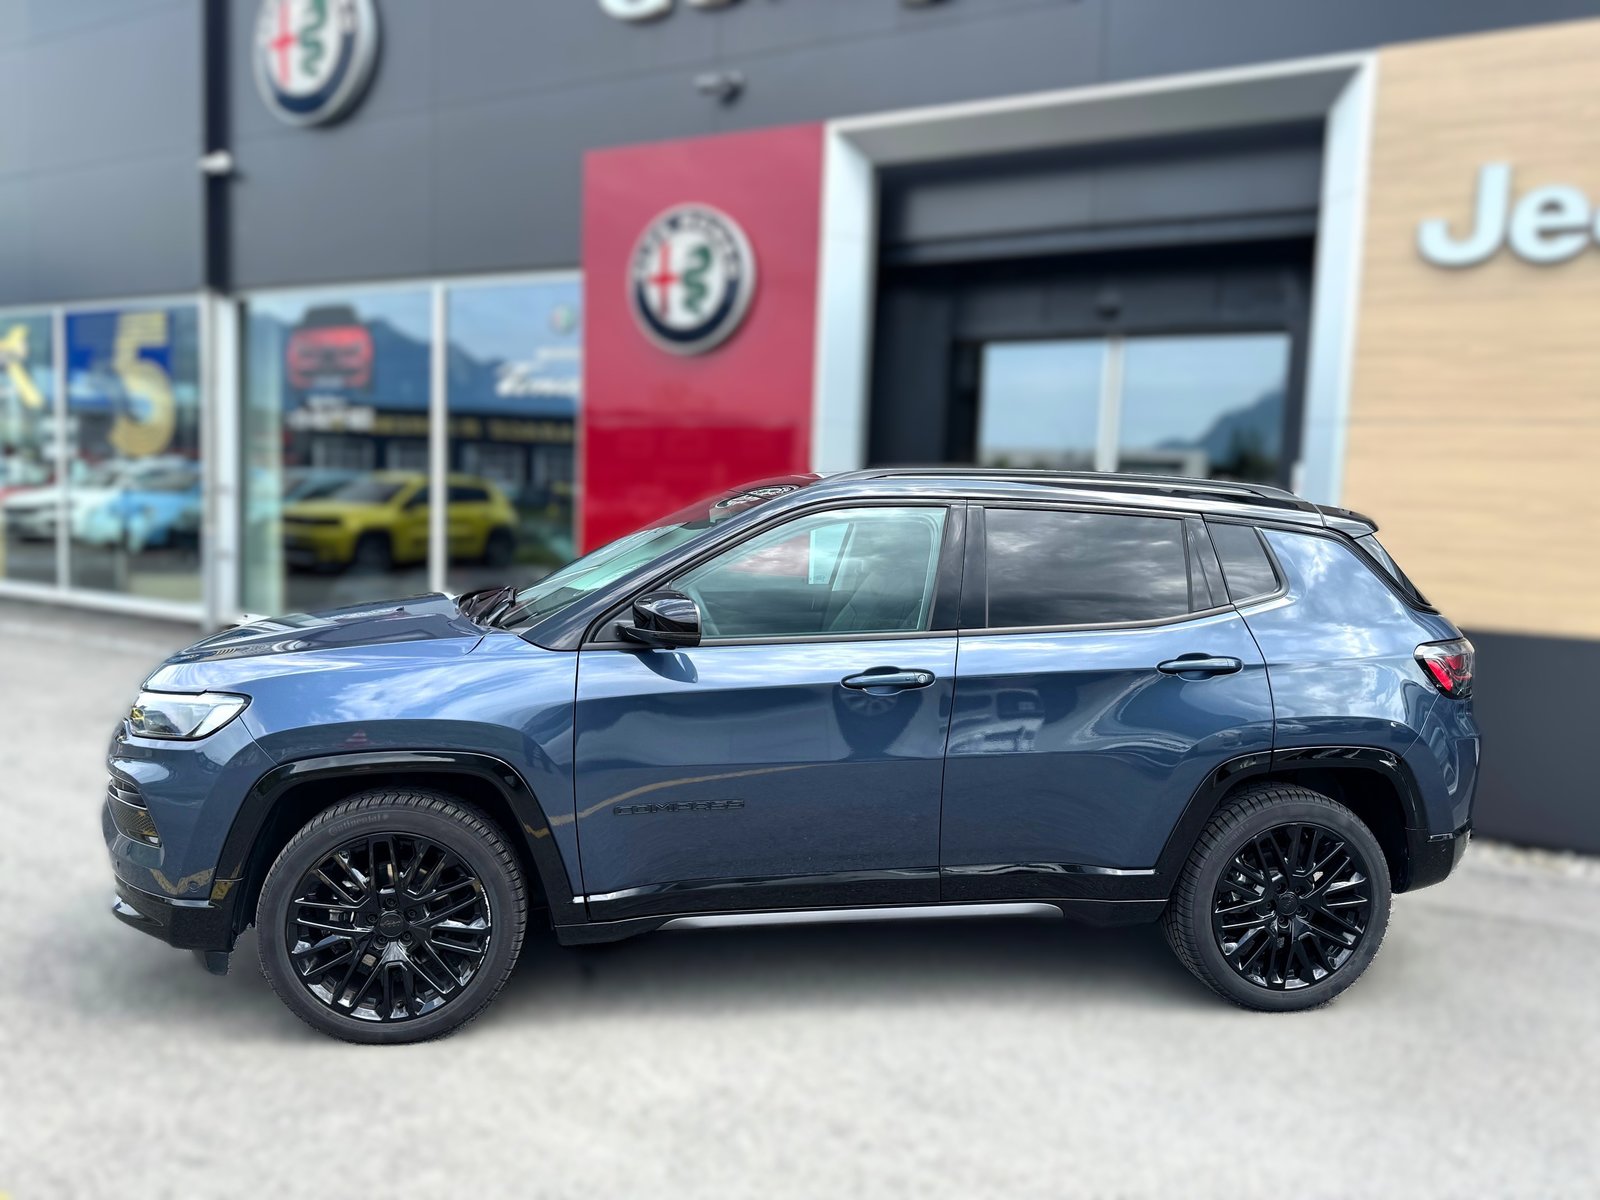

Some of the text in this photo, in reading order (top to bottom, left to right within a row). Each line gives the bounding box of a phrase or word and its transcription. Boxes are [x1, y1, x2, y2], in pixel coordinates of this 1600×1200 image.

[1417, 160, 1600, 266] Je
[110, 311, 176, 458] 5
[613, 799, 745, 816] COMPASS
